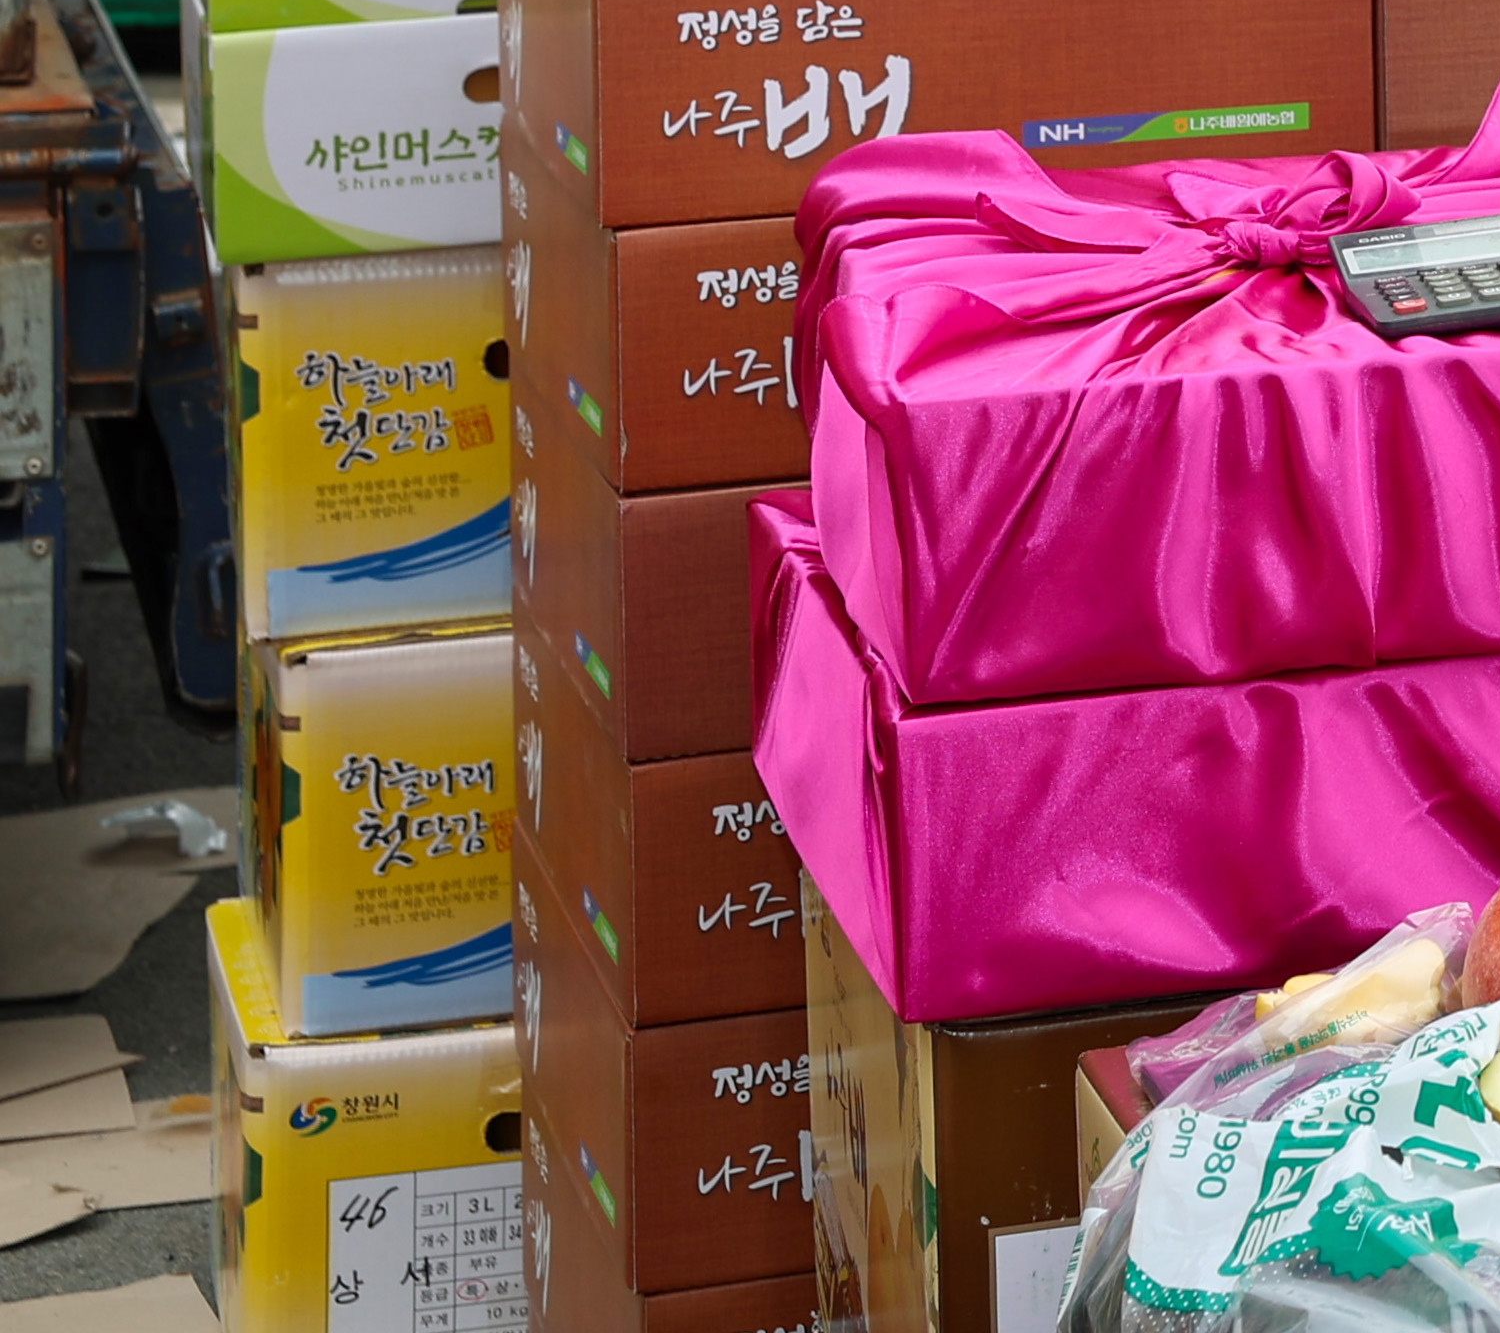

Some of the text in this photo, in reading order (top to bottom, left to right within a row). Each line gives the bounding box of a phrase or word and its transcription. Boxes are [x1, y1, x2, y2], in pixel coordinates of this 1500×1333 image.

[676, 0, 864, 51] 정성을 담은
[1039, 122, 1086, 143] NH
[337, 167, 496, 193] Shinemuscat
[1357, 231, 1406, 245] CASIO
[316, 403, 452, 474] 첫단감
[353, 807, 489, 877] 첫단감
[340, 1092, 400, 1116] 창원시
[1195, 1117, 1248, 1201] 1980
[420, 1199, 450, 1217] 크기
[420, 1230, 449, 1249] 개수
[420, 1285, 449, 1303] 등급
[420, 1309, 449, 1327] 무게
[486, 1305, 503, 1320] 10
